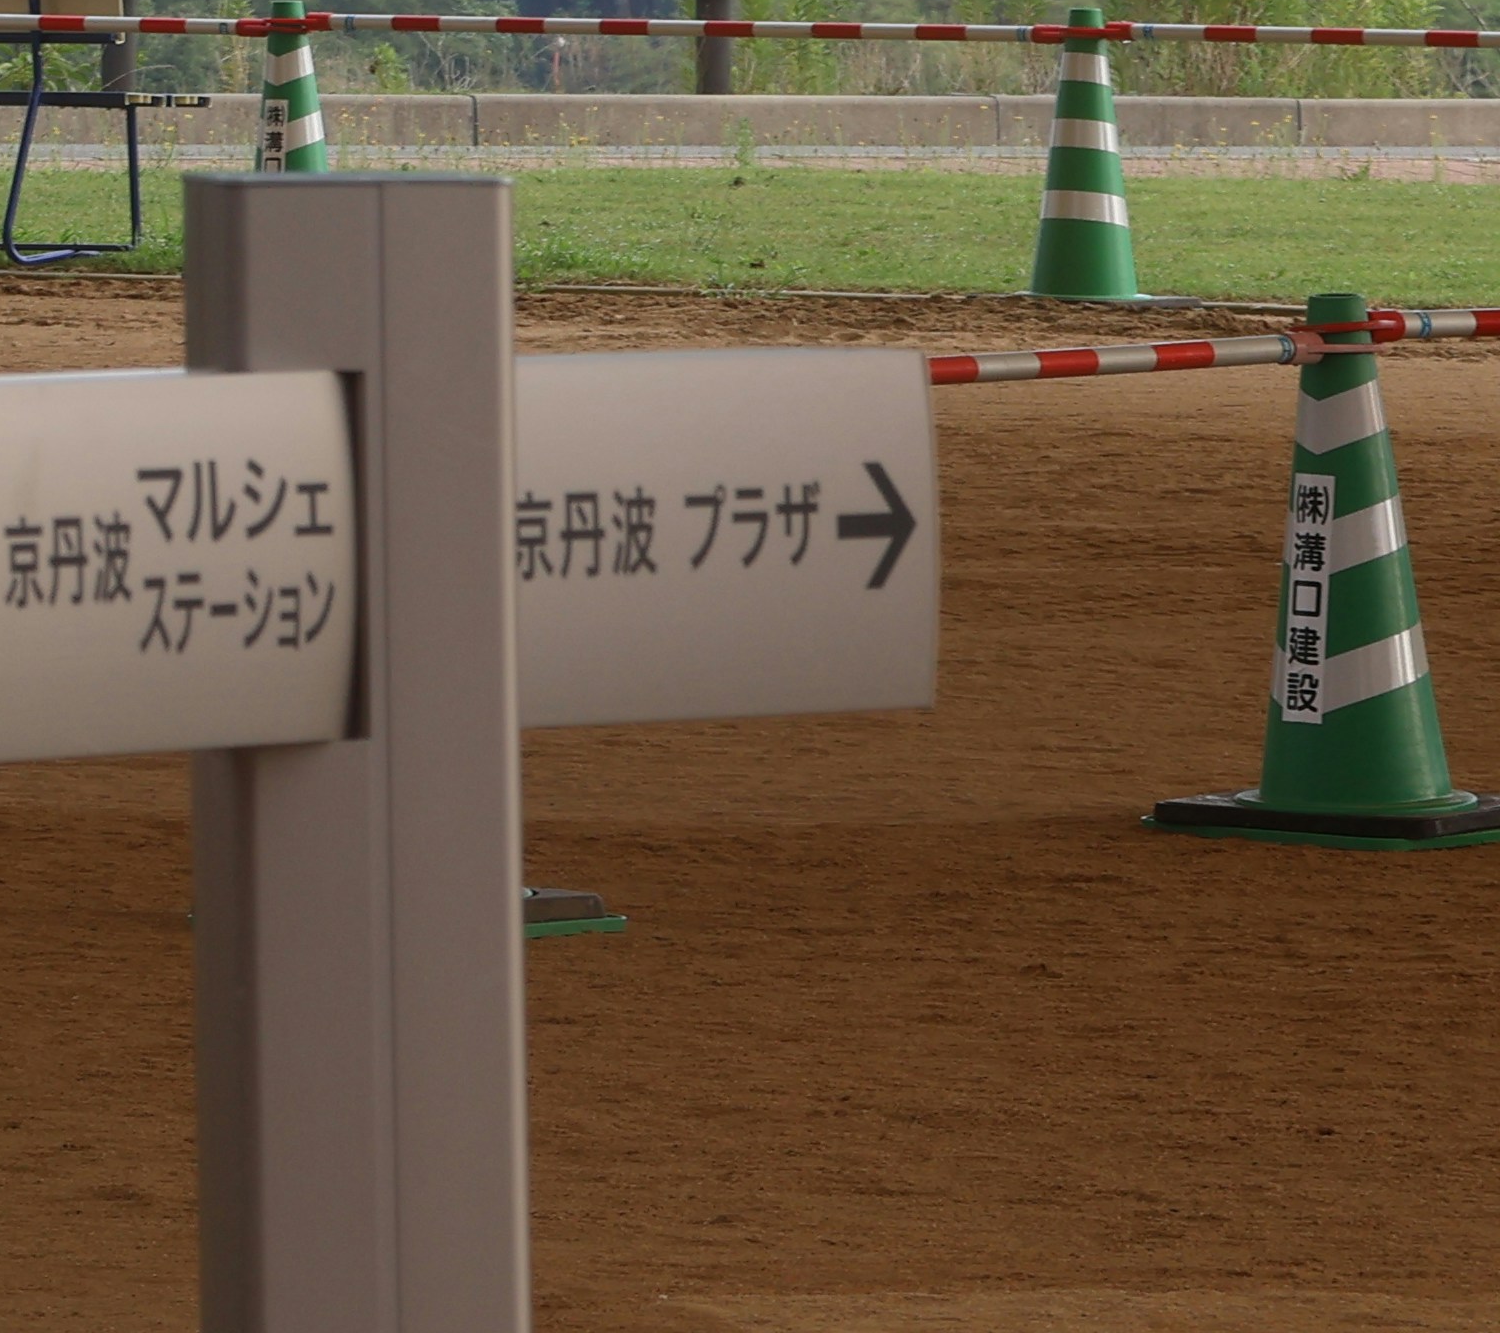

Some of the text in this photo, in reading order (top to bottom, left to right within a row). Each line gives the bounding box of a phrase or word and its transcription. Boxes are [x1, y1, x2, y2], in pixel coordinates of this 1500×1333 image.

[136, 457, 334, 543] マルシェ
[515, 480, 823, 581] 京丹波 プラザ
[4, 510, 133, 610] 京丹波
[138, 566, 336, 655] ステーション
